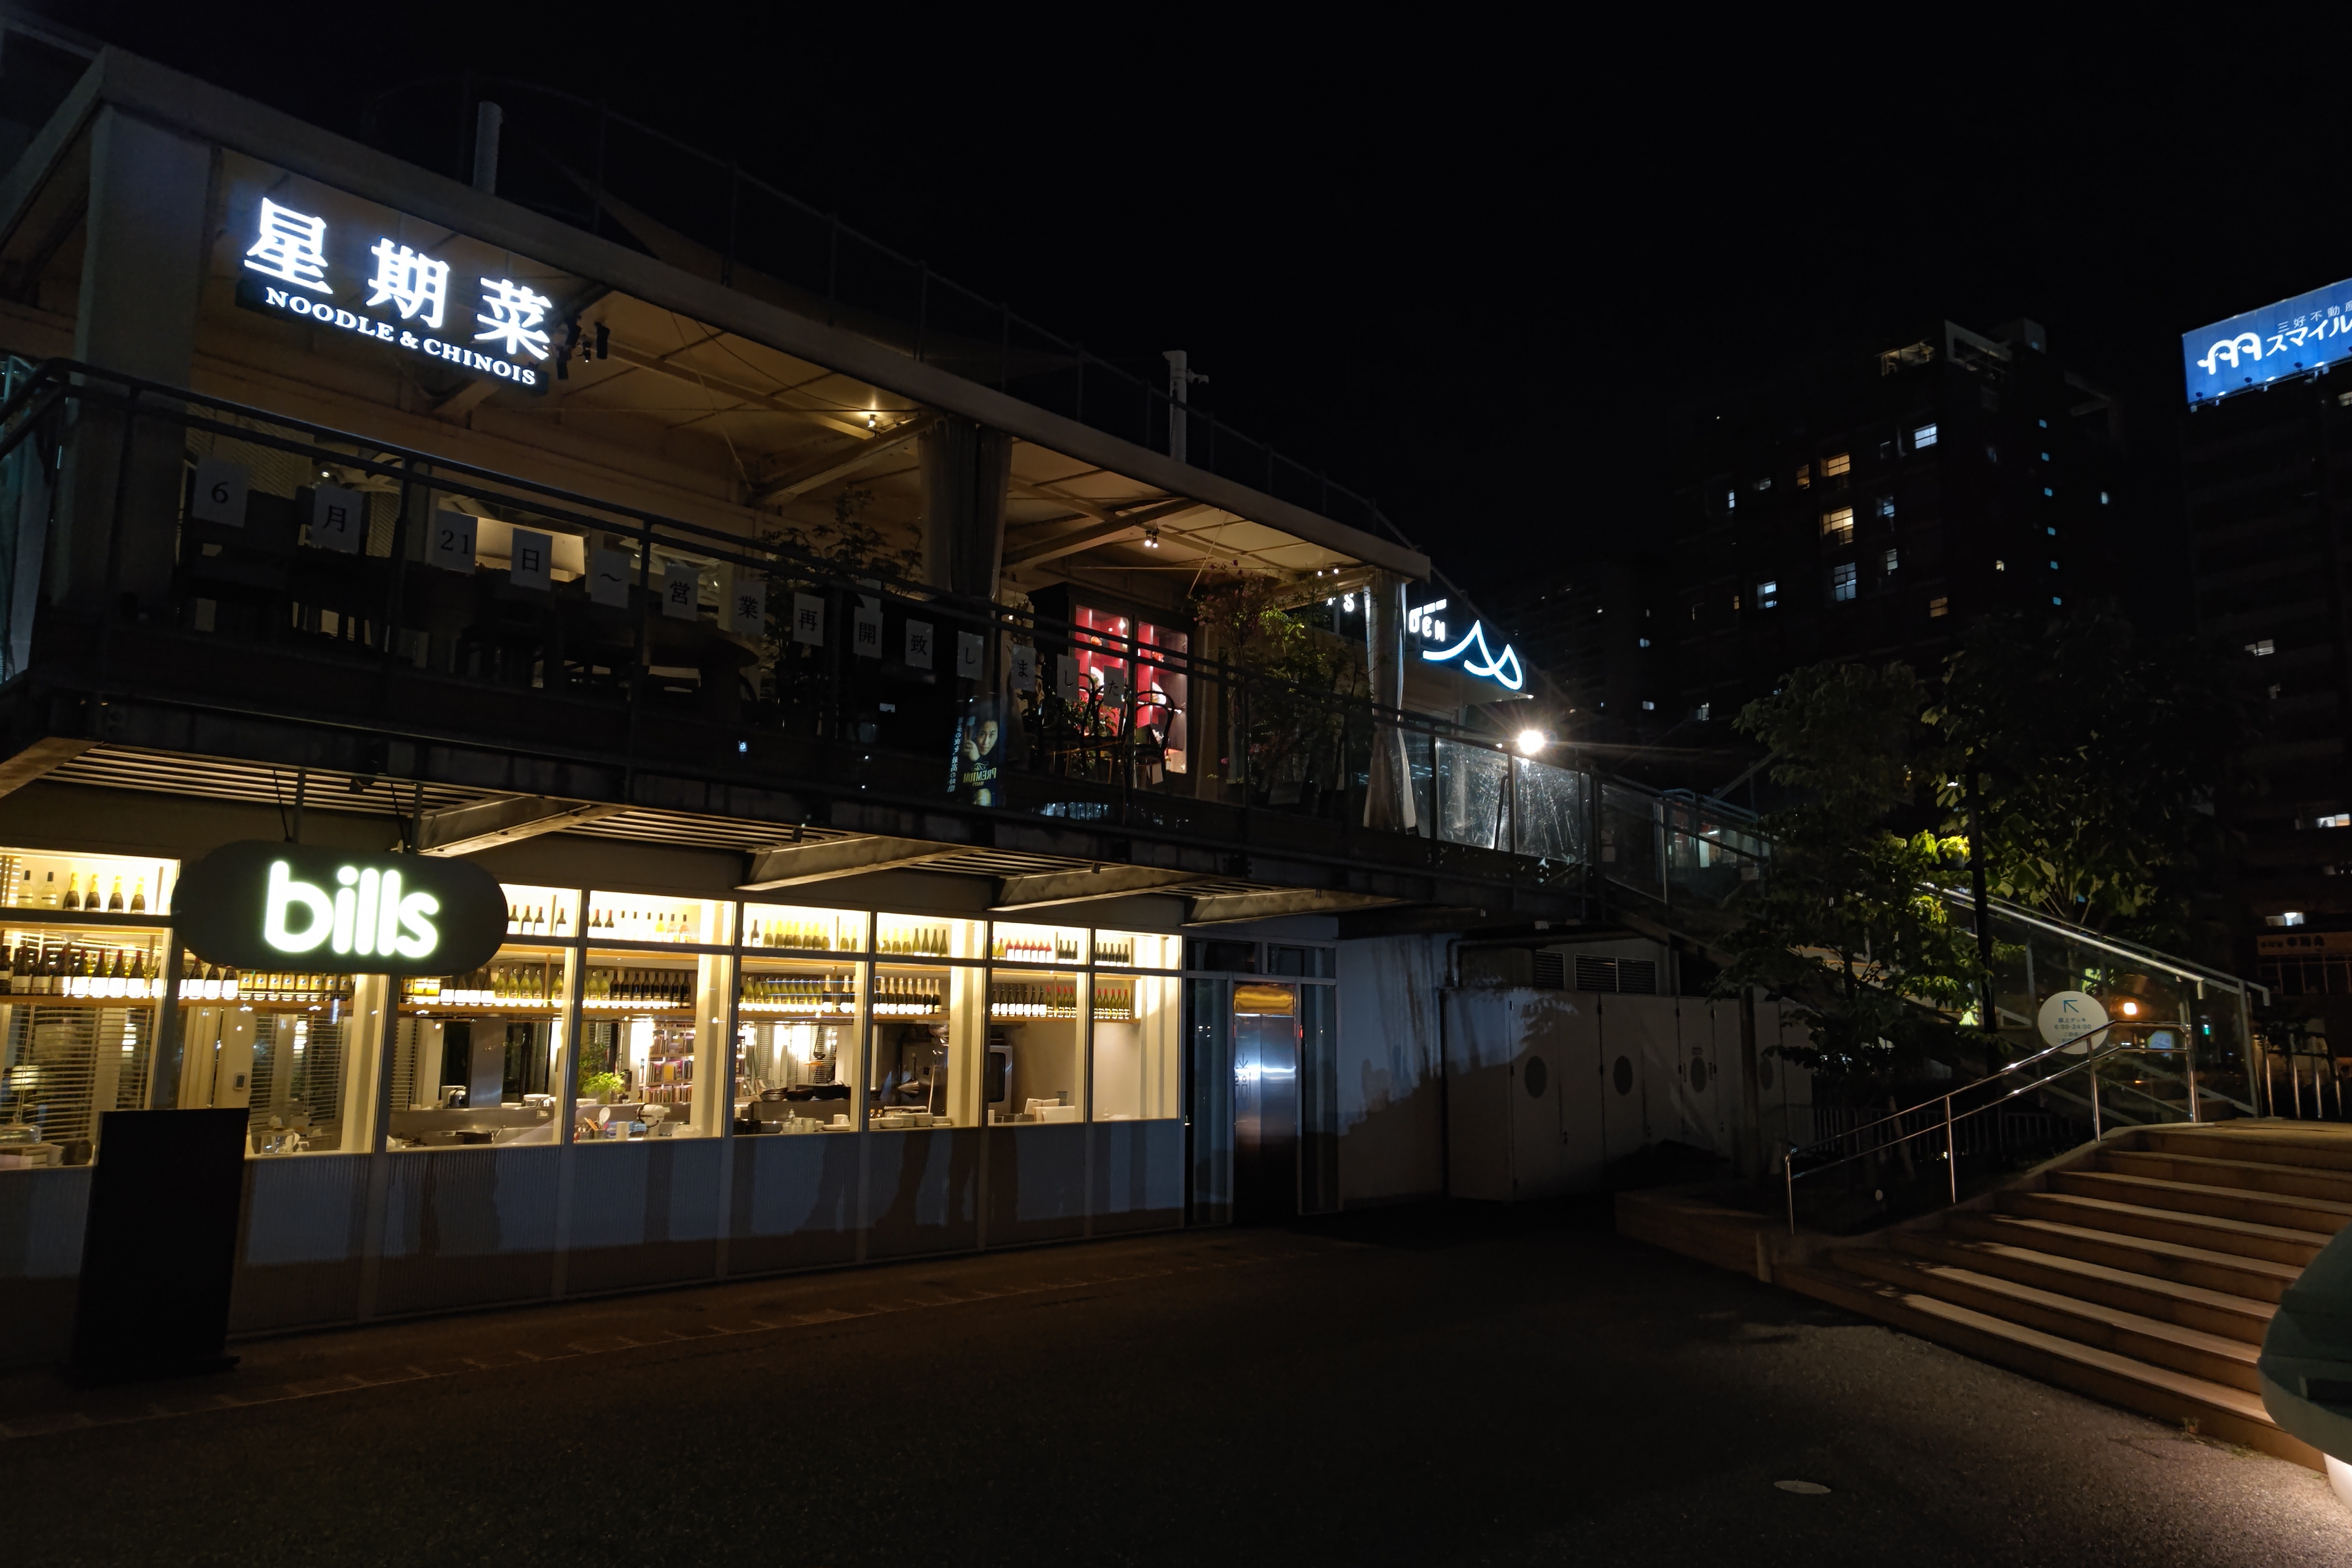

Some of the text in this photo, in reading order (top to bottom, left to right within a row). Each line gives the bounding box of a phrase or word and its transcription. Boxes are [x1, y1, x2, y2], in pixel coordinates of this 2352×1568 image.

[244, 197, 553, 360] 星期菜
[265, 287, 536, 386] NOODLE & CHINOIS
[265, 861, 440, 958] bills
